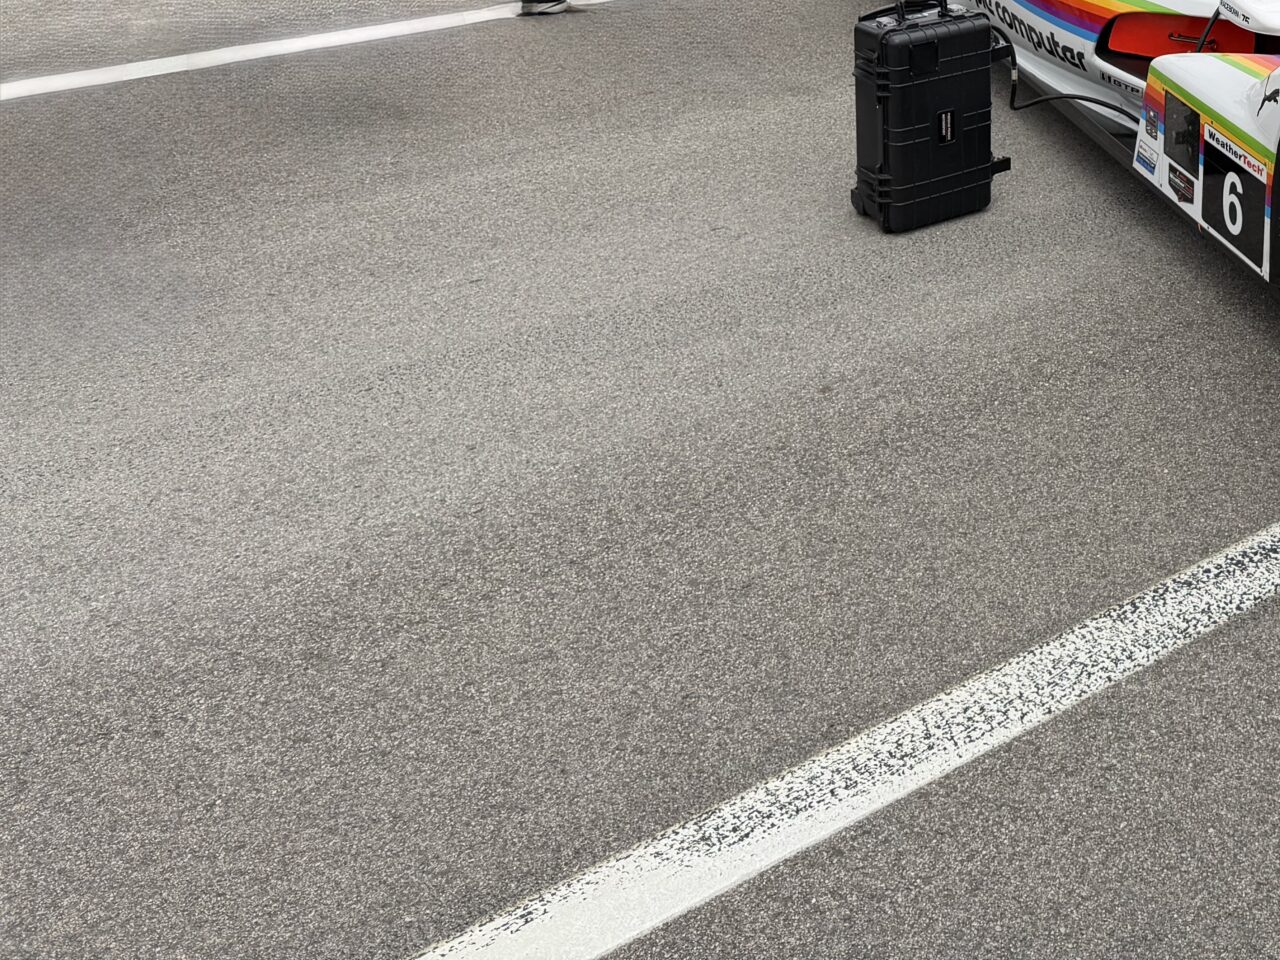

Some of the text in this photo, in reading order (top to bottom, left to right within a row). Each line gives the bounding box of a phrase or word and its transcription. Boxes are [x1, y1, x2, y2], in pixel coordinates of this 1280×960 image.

[998, 0, 1088, 72] computer
[1207, 129, 1264, 177] WeatherTech
[1223, 171, 1244, 236] 6
